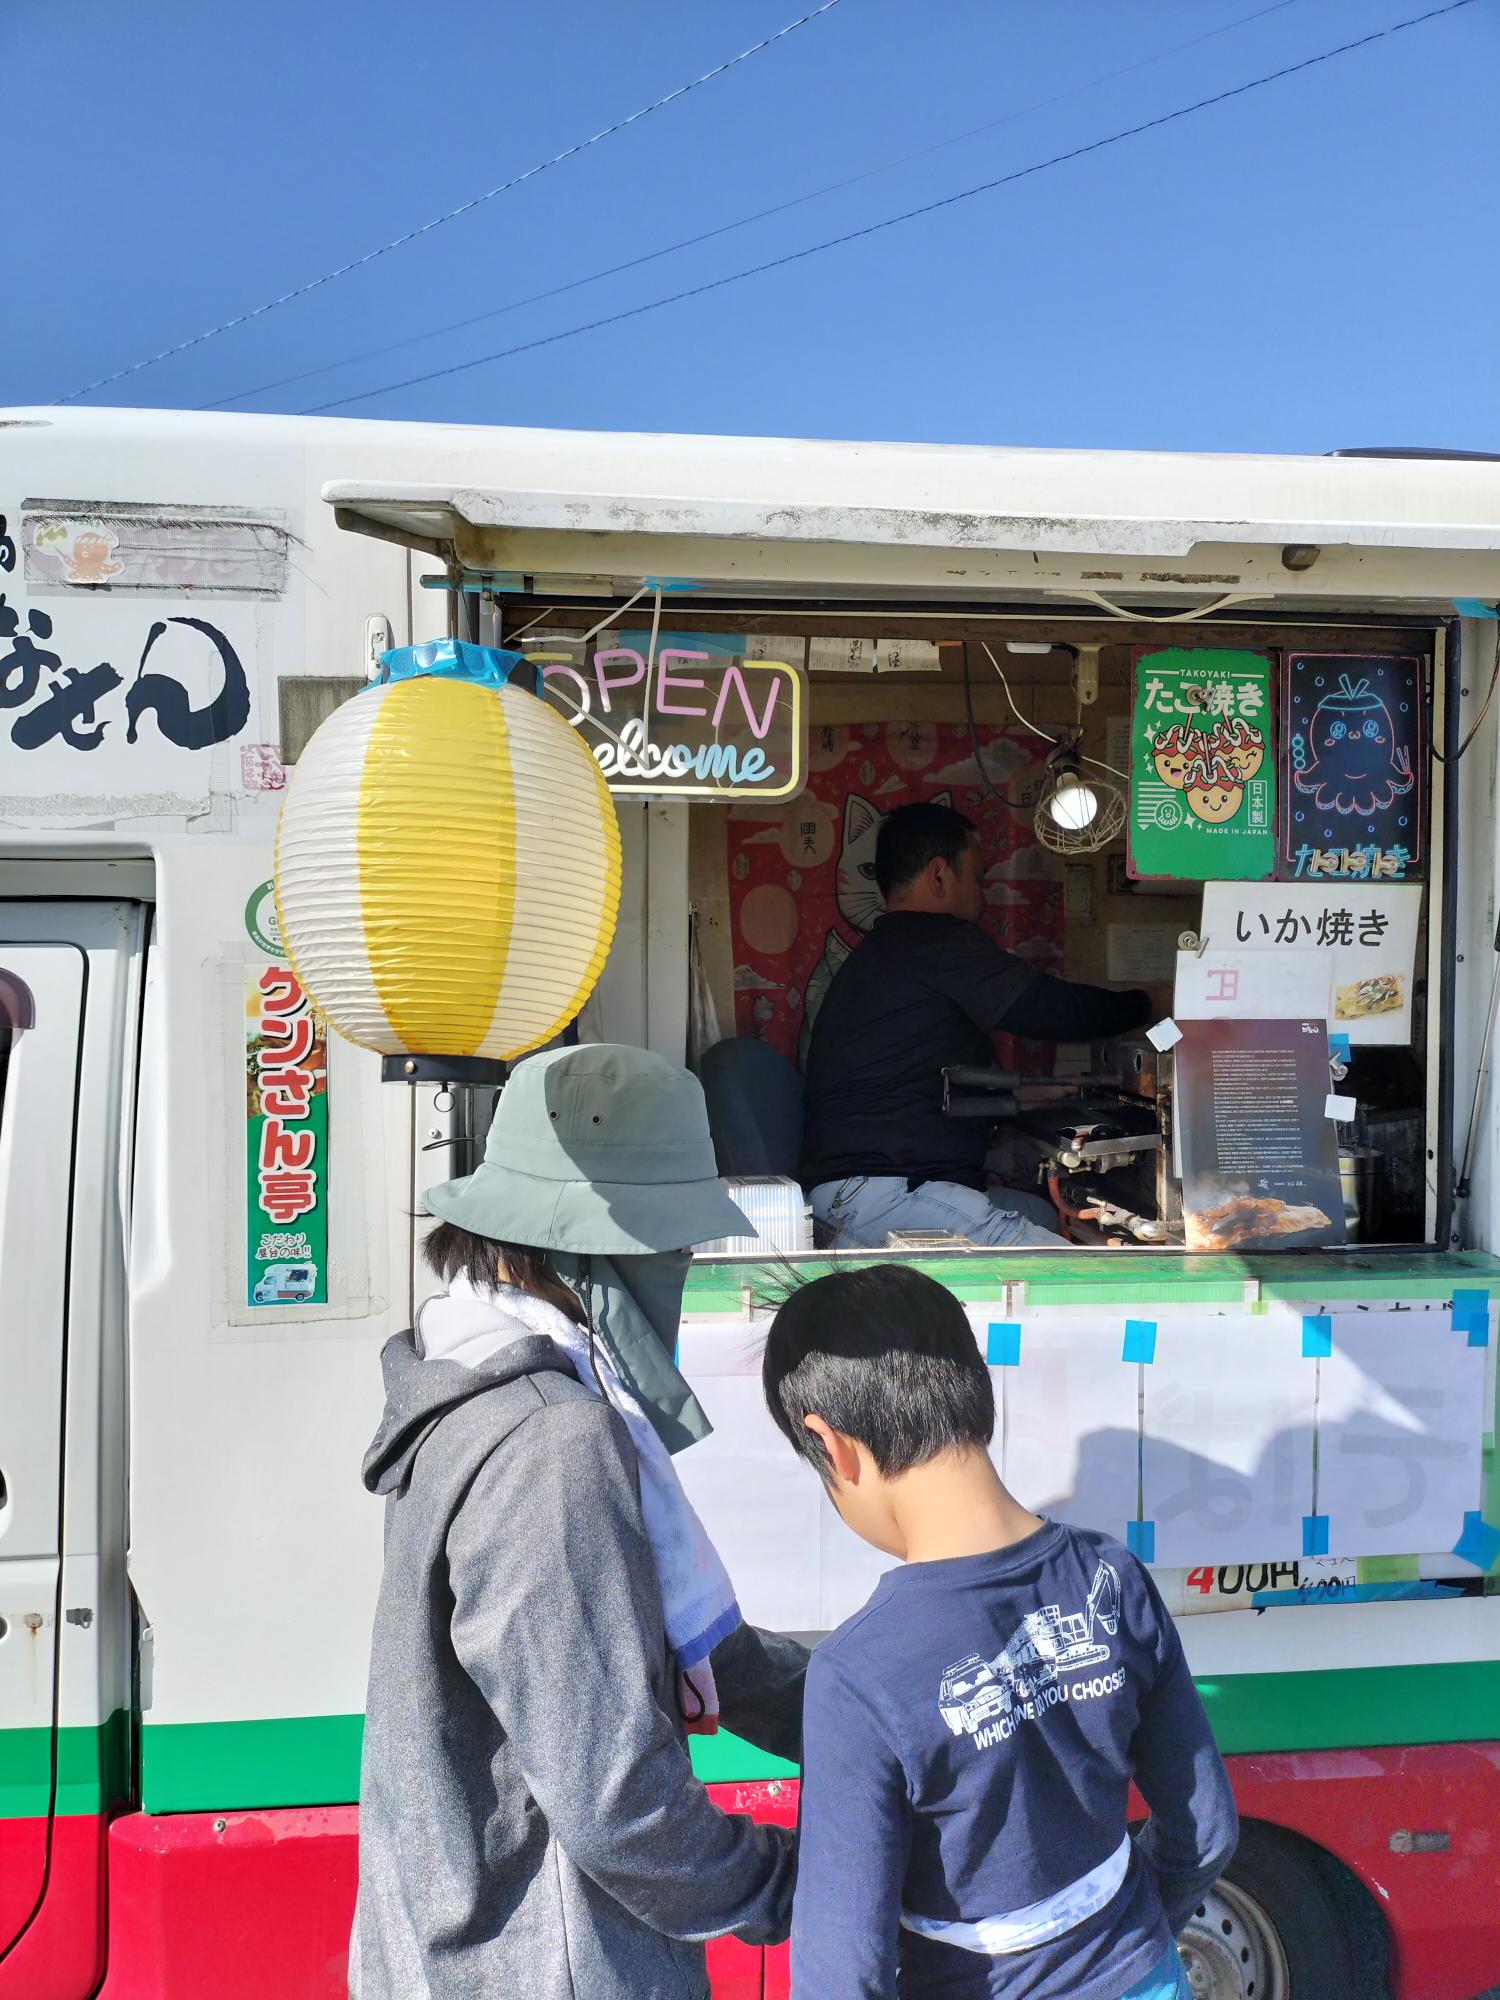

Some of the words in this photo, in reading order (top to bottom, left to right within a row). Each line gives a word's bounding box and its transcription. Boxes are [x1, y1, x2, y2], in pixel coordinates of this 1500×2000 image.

[543, 648, 781, 739] OPEN
[1180, 669, 1231, 679] TAKOYAKI
[588, 718, 775, 783] elcome
[1251, 782, 1264, 824] 日本製
[1236, 908, 1390, 947] いか焼き
[261, 1233, 306, 1246] こだわり
[974, 1715, 1016, 1751] WHICH
[1013, 1702, 1035, 1727] ONE
[1043, 1685, 1068, 1708] YOU
